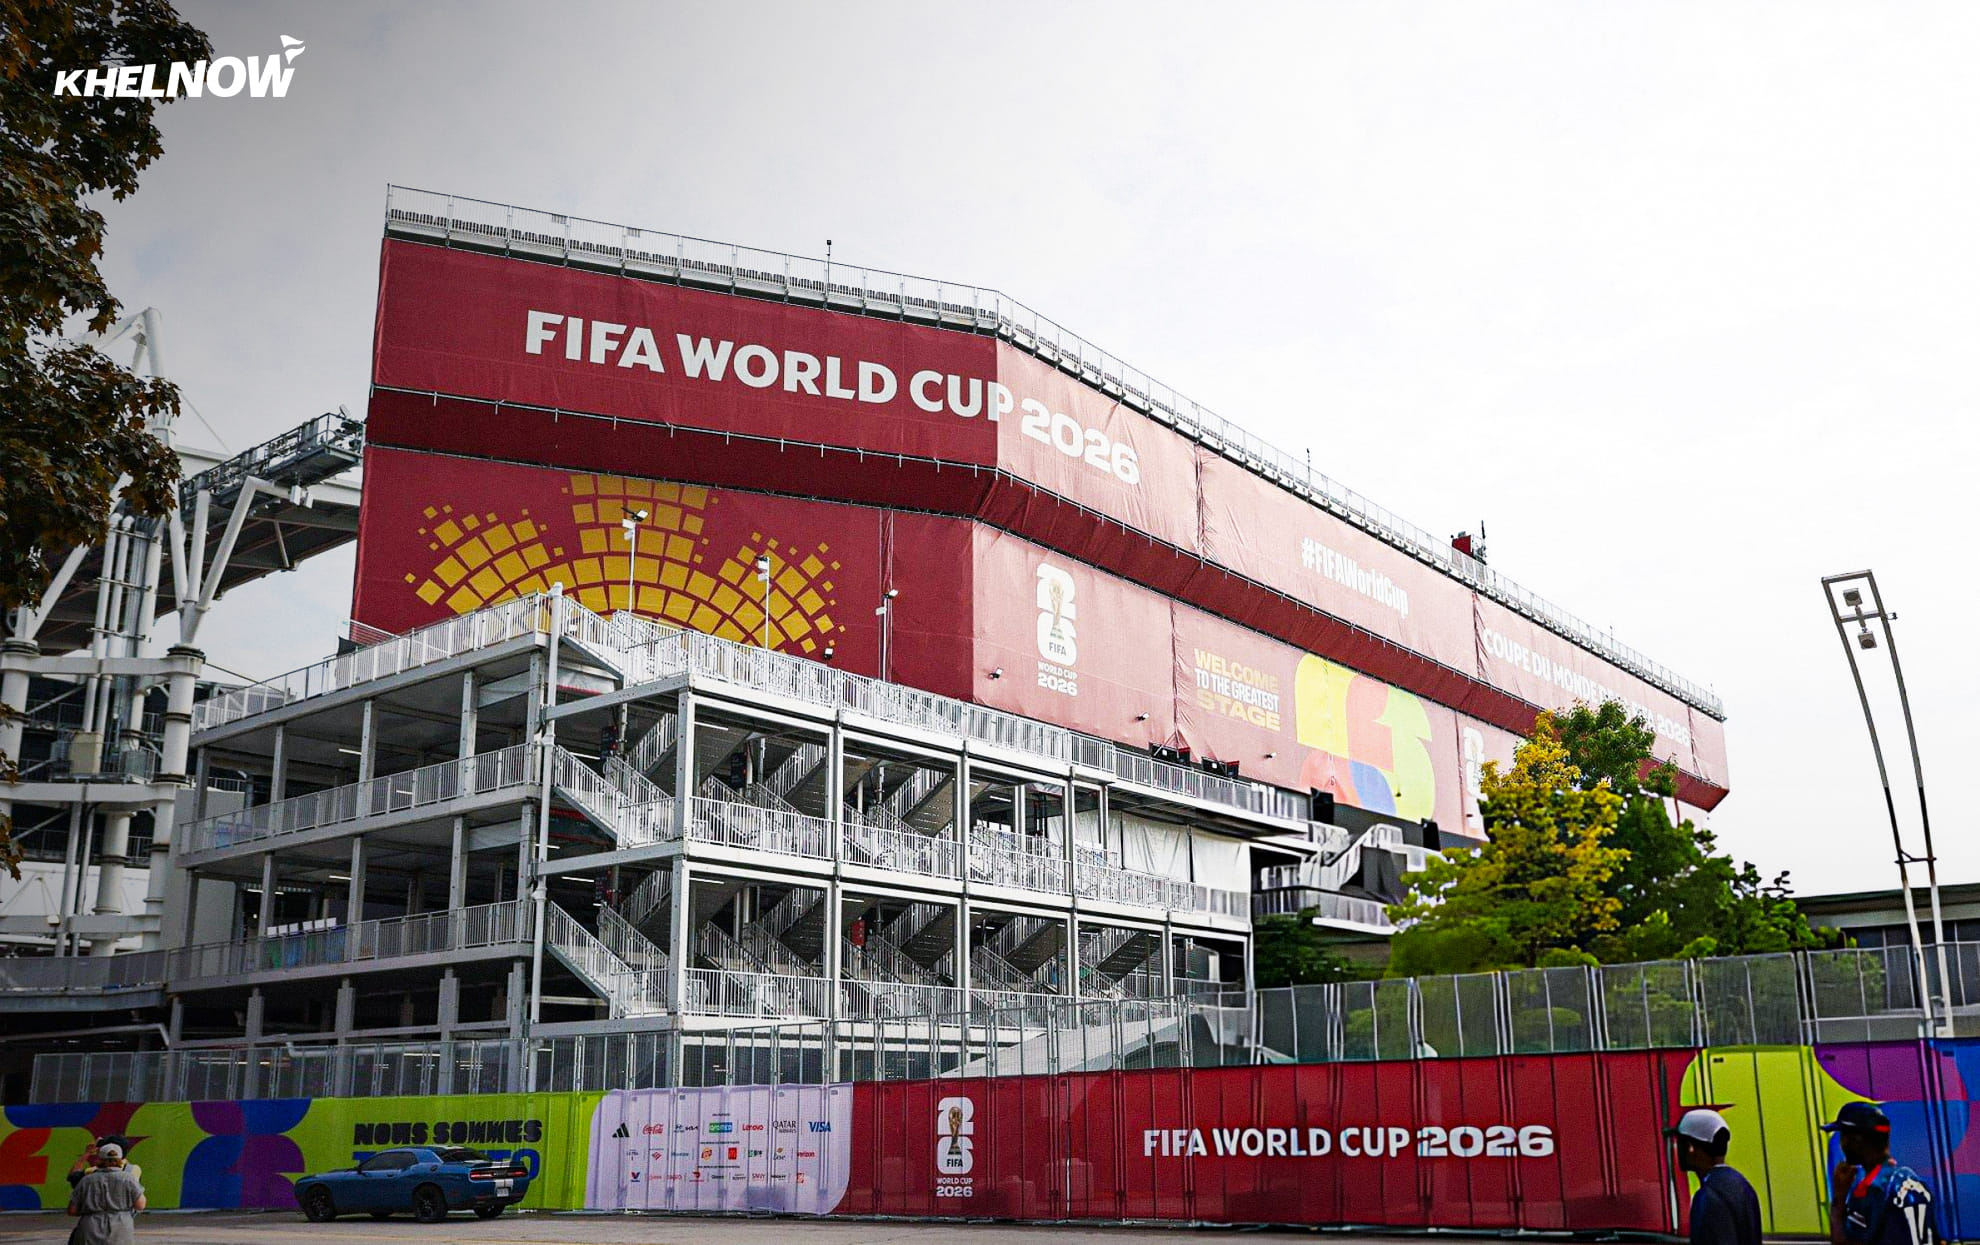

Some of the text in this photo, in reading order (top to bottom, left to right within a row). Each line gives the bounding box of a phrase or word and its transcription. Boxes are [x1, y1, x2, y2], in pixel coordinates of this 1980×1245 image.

[526, 310, 1142, 489] FIFA WORLD CUP 2026
[1301, 537, 1409, 619] #FIFAWorldCup
[1048, 641, 1067, 656] FIFA
[1037, 661, 1078, 680] WORLD CUP
[1194, 648, 1280, 695] WELCOME
[1037, 672, 1078, 697] 2026
[1194, 668, 1280, 713] TO THE GREATEST
[1482, 628, 1531, 673] COUPE
[1531, 651, 1552, 682] DU
[1552, 662, 1599, 703] MONDE
[1657, 713, 1691, 748] 2026
[1196, 688, 1280, 732] STAGE
[353, 1119, 543, 1146] NOUS SOMMES
[773, 1120, 797, 1130] QATAR
[808, 1121, 832, 1133] VISA
[1143, 1125, 1554, 1158] FIFA WORLD CUP 2026
[946, 1158, 964, 1168] FIFA
[936, 1177, 973, 1185] WORLD CUP
[936, 1185, 973, 1198] 2026
